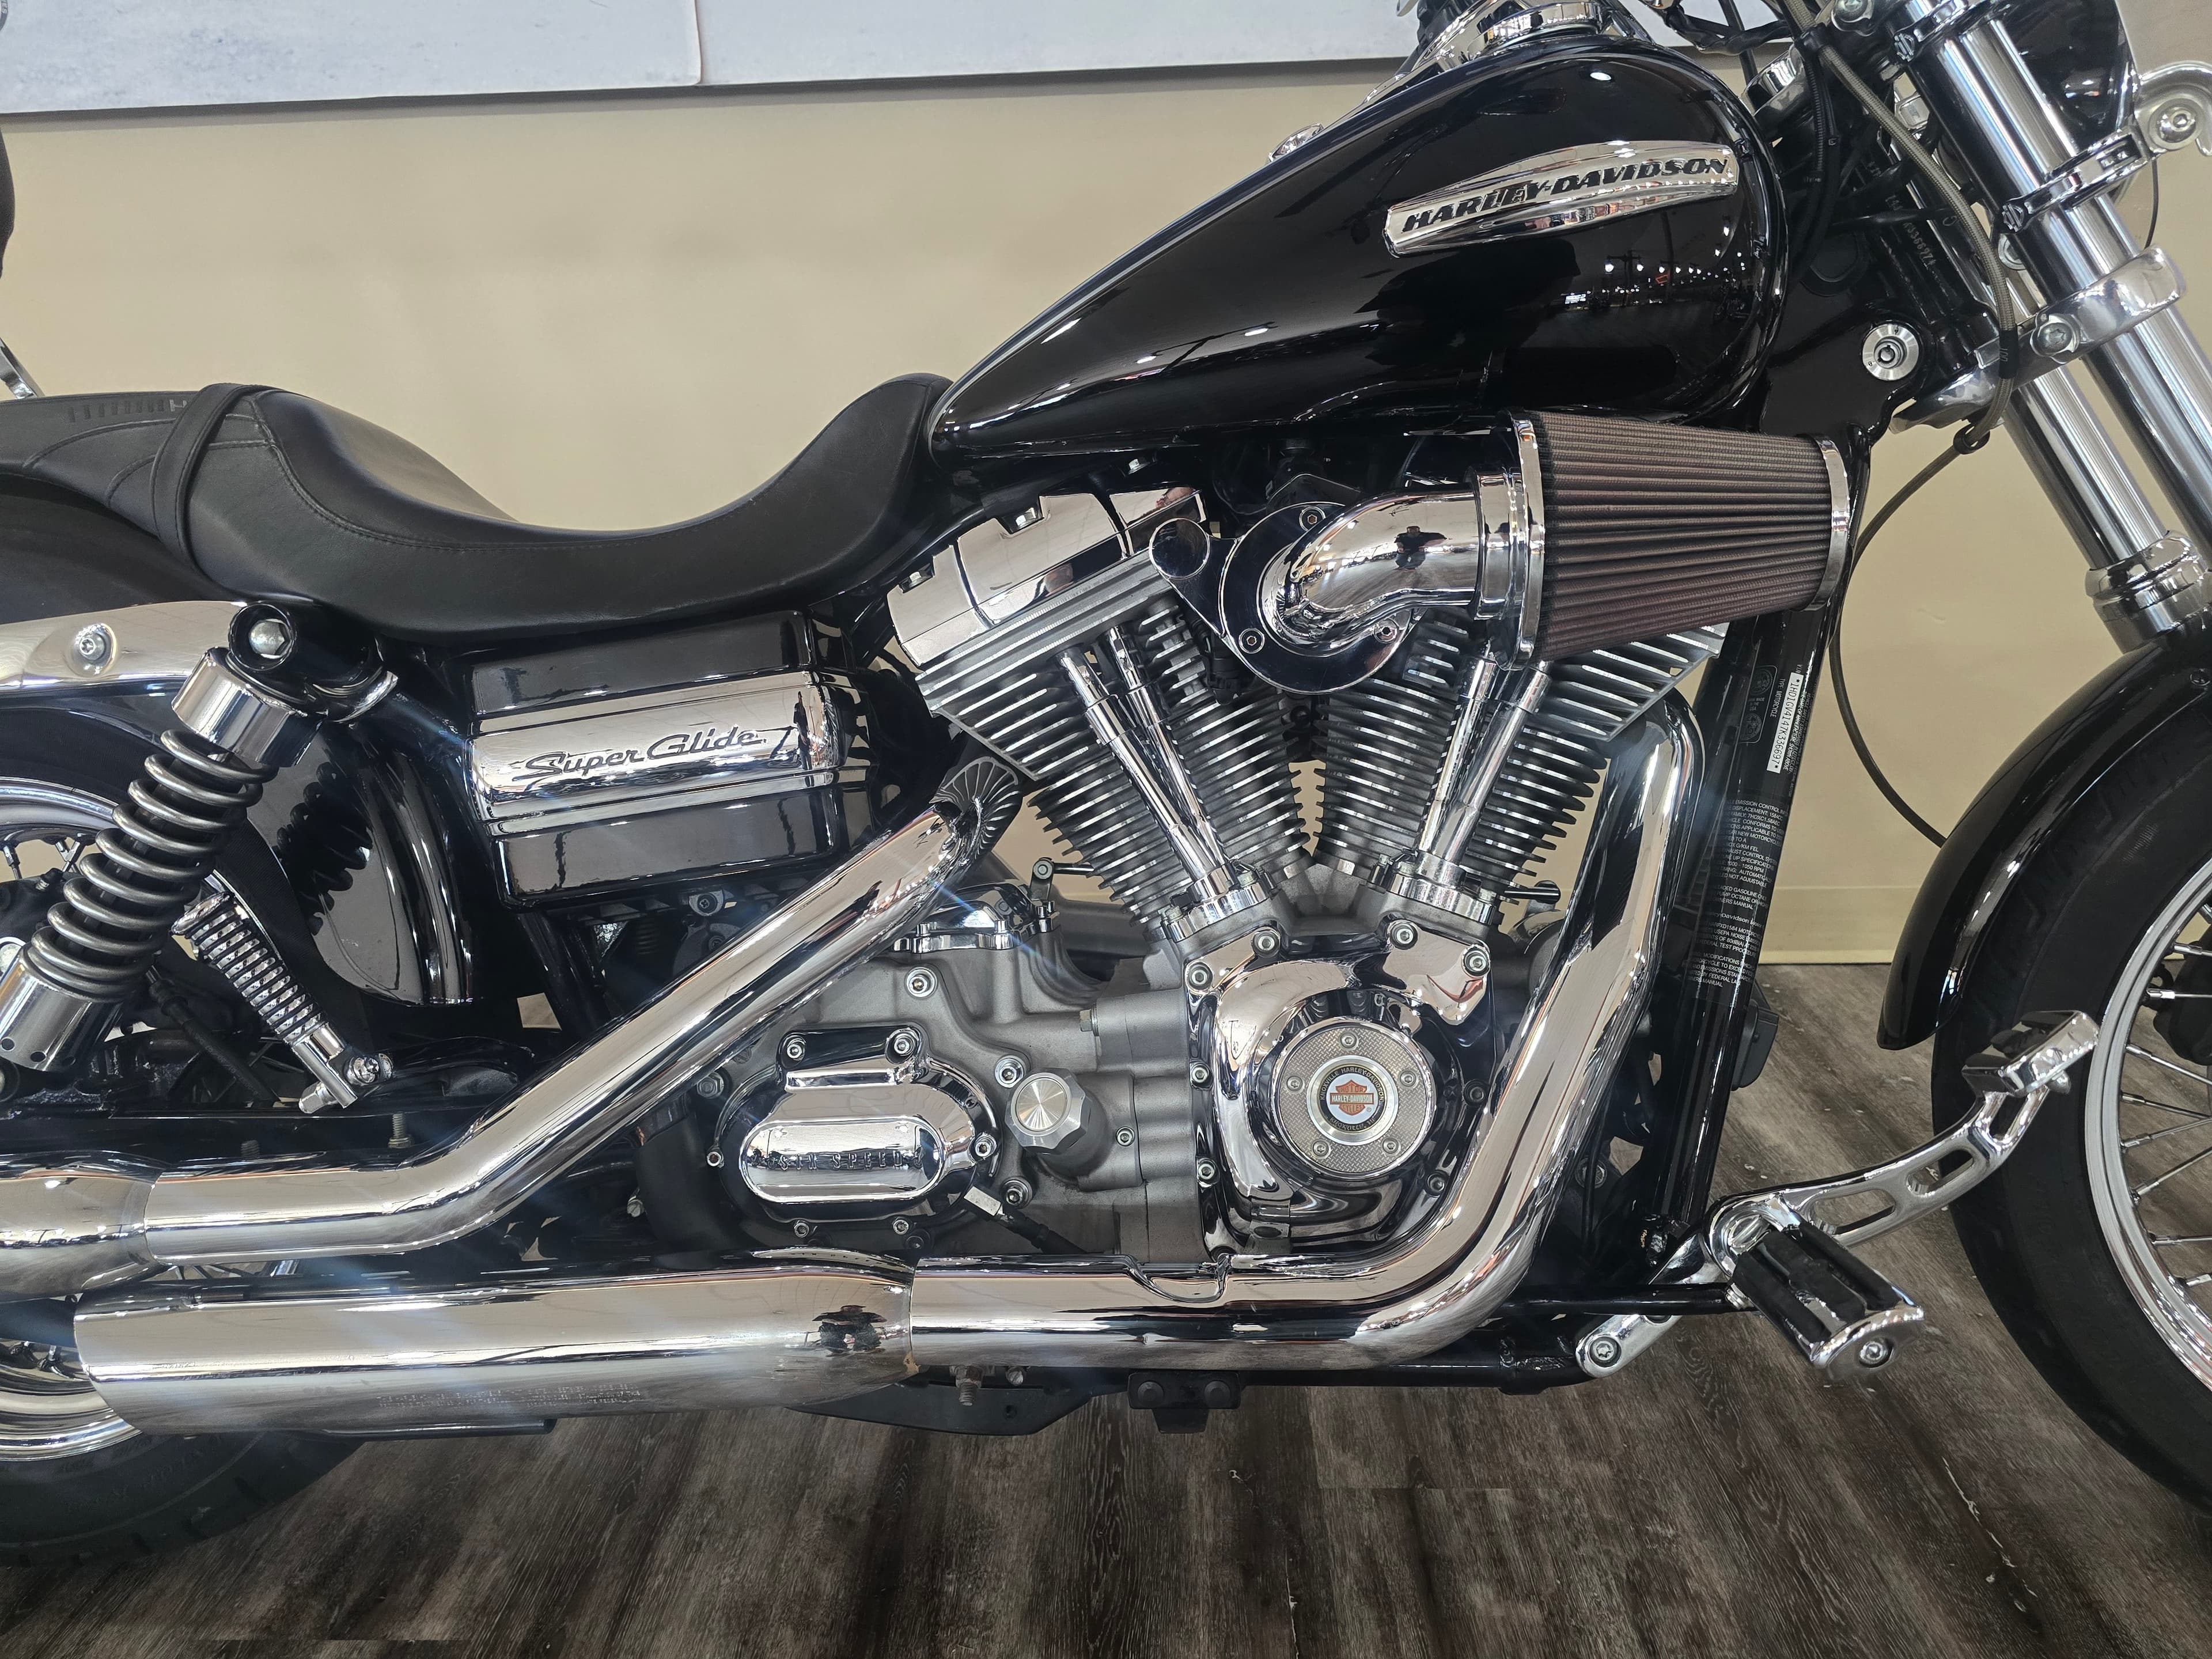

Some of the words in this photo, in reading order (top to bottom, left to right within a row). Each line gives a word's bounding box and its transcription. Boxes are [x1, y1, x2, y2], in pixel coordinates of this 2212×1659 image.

[1402, 157, 1729, 233] HARLEY-DAVIDSON
[1770, 690, 1782, 718] MOTORCYCLE
[511, 749, 643, 782] Super
[647, 726, 767, 760] Glide
[1758, 803, 1780, 813] CONTROL
[1743, 819, 1770, 829] CONFORMS
[1741, 825, 1770, 835] APPLICABLE
[1743, 851, 1764, 860] CONTROL
[1740, 876, 1767, 888] ADJUSTABLE
[1731, 893, 1751, 902] OCTANE
[1733, 888, 1758, 898] GASOLINE
[1733, 900, 1753, 910] MANUAL
[1730, 932, 1745, 940] NOISE
[1702, 978, 1723, 987] MANUAL
[1709, 973, 1730, 982] FEDERAL
[1320, 1070, 1339, 1100] KNOXVILLE
[1341, 1067, 1384, 1102] HARLEY-DAVIDSON
[832, 1151, 903, 1171] SPEED
